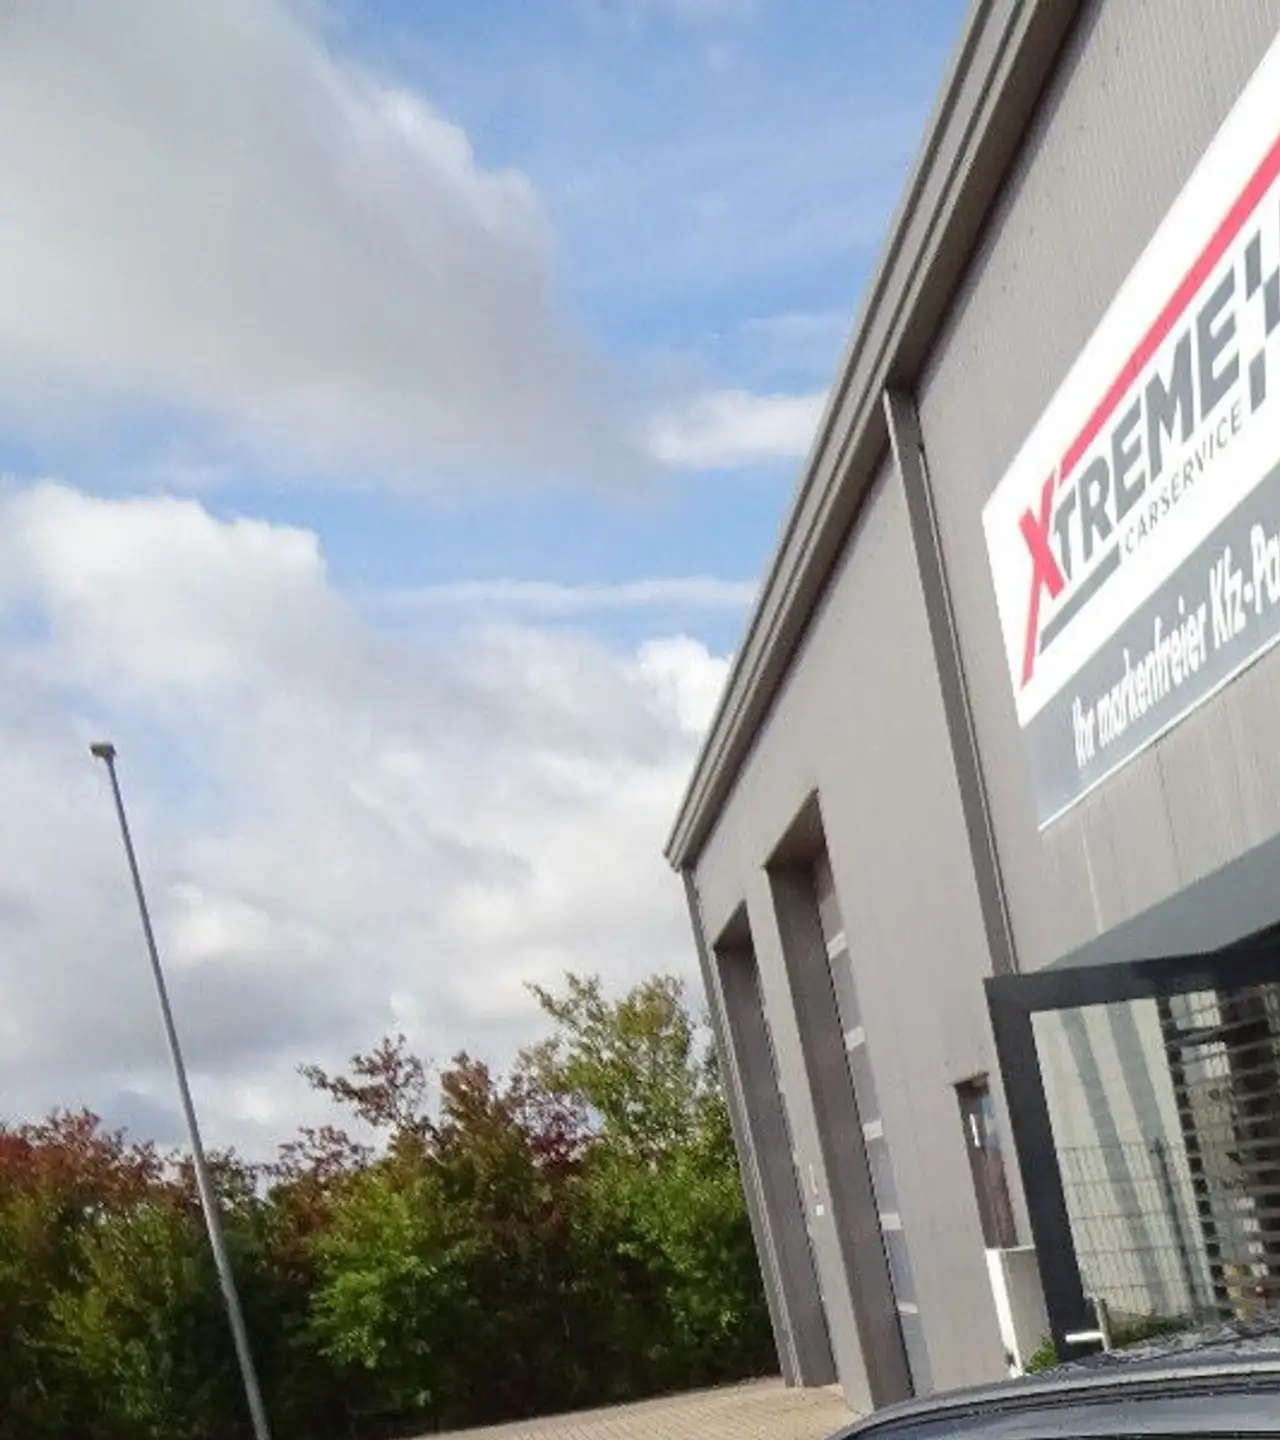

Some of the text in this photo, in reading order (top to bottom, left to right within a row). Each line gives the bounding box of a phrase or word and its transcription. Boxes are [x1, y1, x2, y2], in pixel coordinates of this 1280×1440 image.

[1018, 276, 1242, 686] XTREME
[1121, 399, 1244, 556] CARSERVICE
[1072, 693, 1097, 769] Ihr
[1097, 594, 1211, 755] markenfreier
